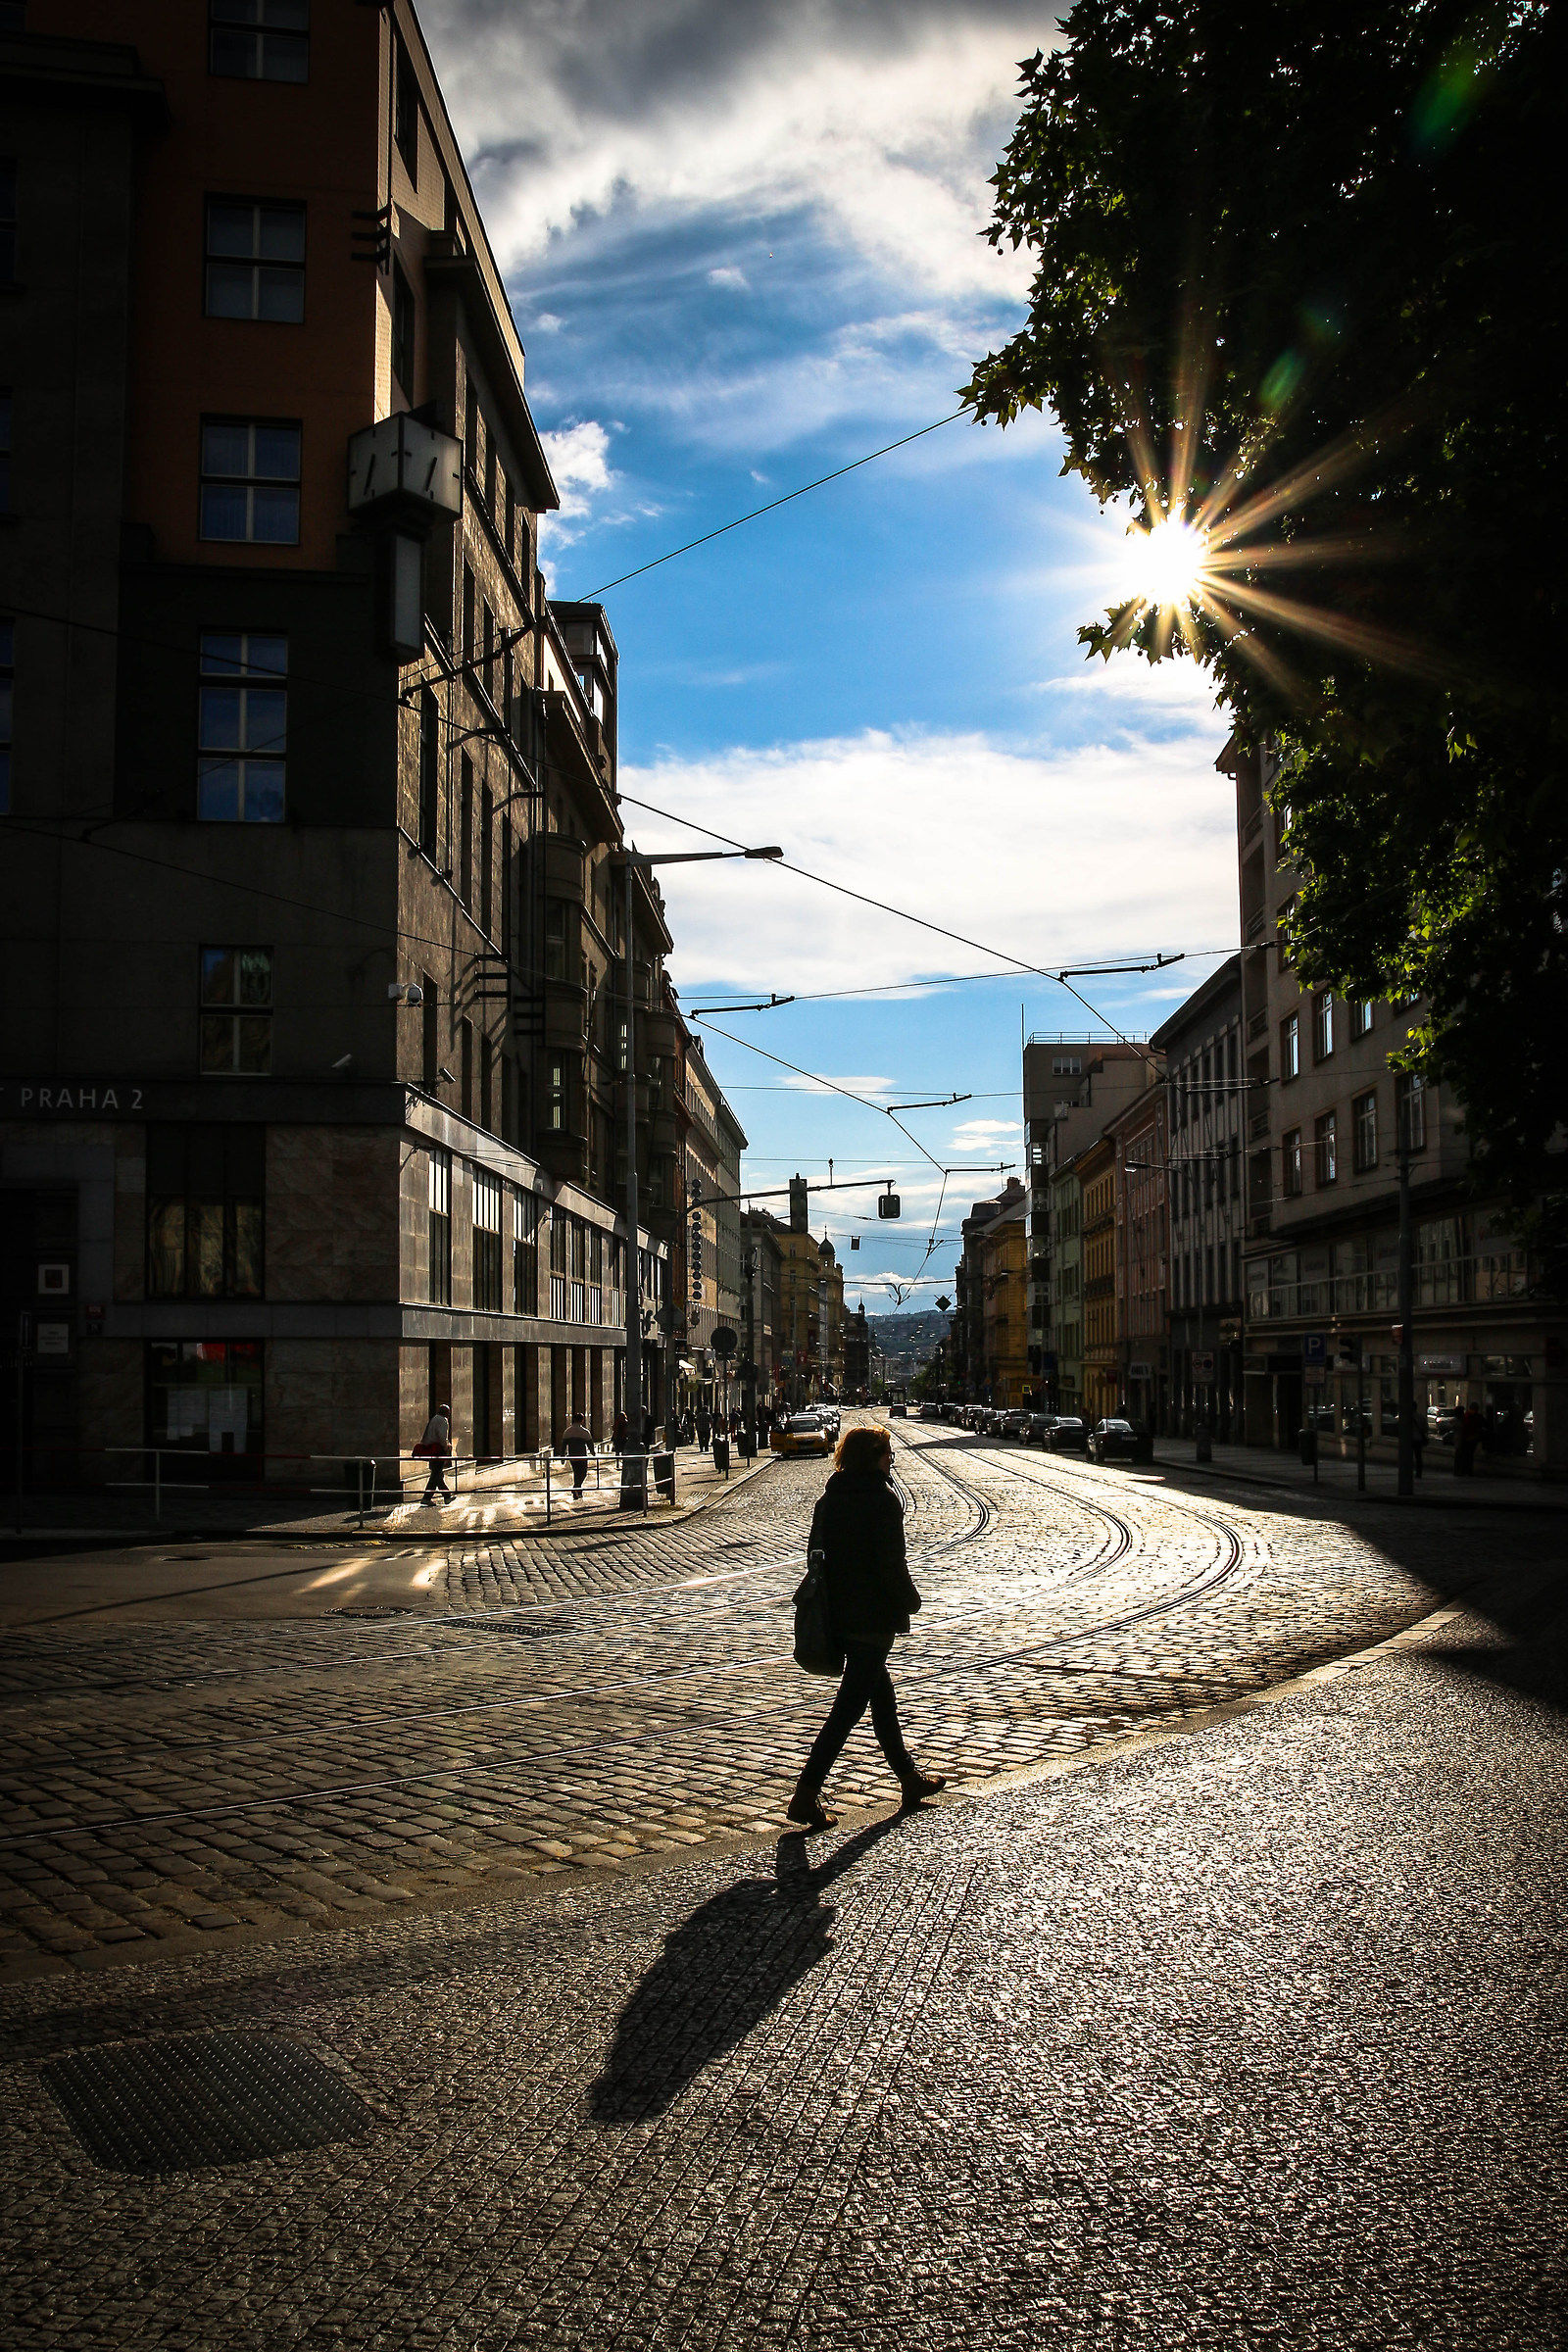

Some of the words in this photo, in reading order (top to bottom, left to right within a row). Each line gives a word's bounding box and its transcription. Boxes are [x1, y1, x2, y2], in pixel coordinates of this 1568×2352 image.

[20, 1087, 119, 1109] PRAHA
[130, 1088, 144, 1109] 2
[1308, 1336, 1321, 1354] P
